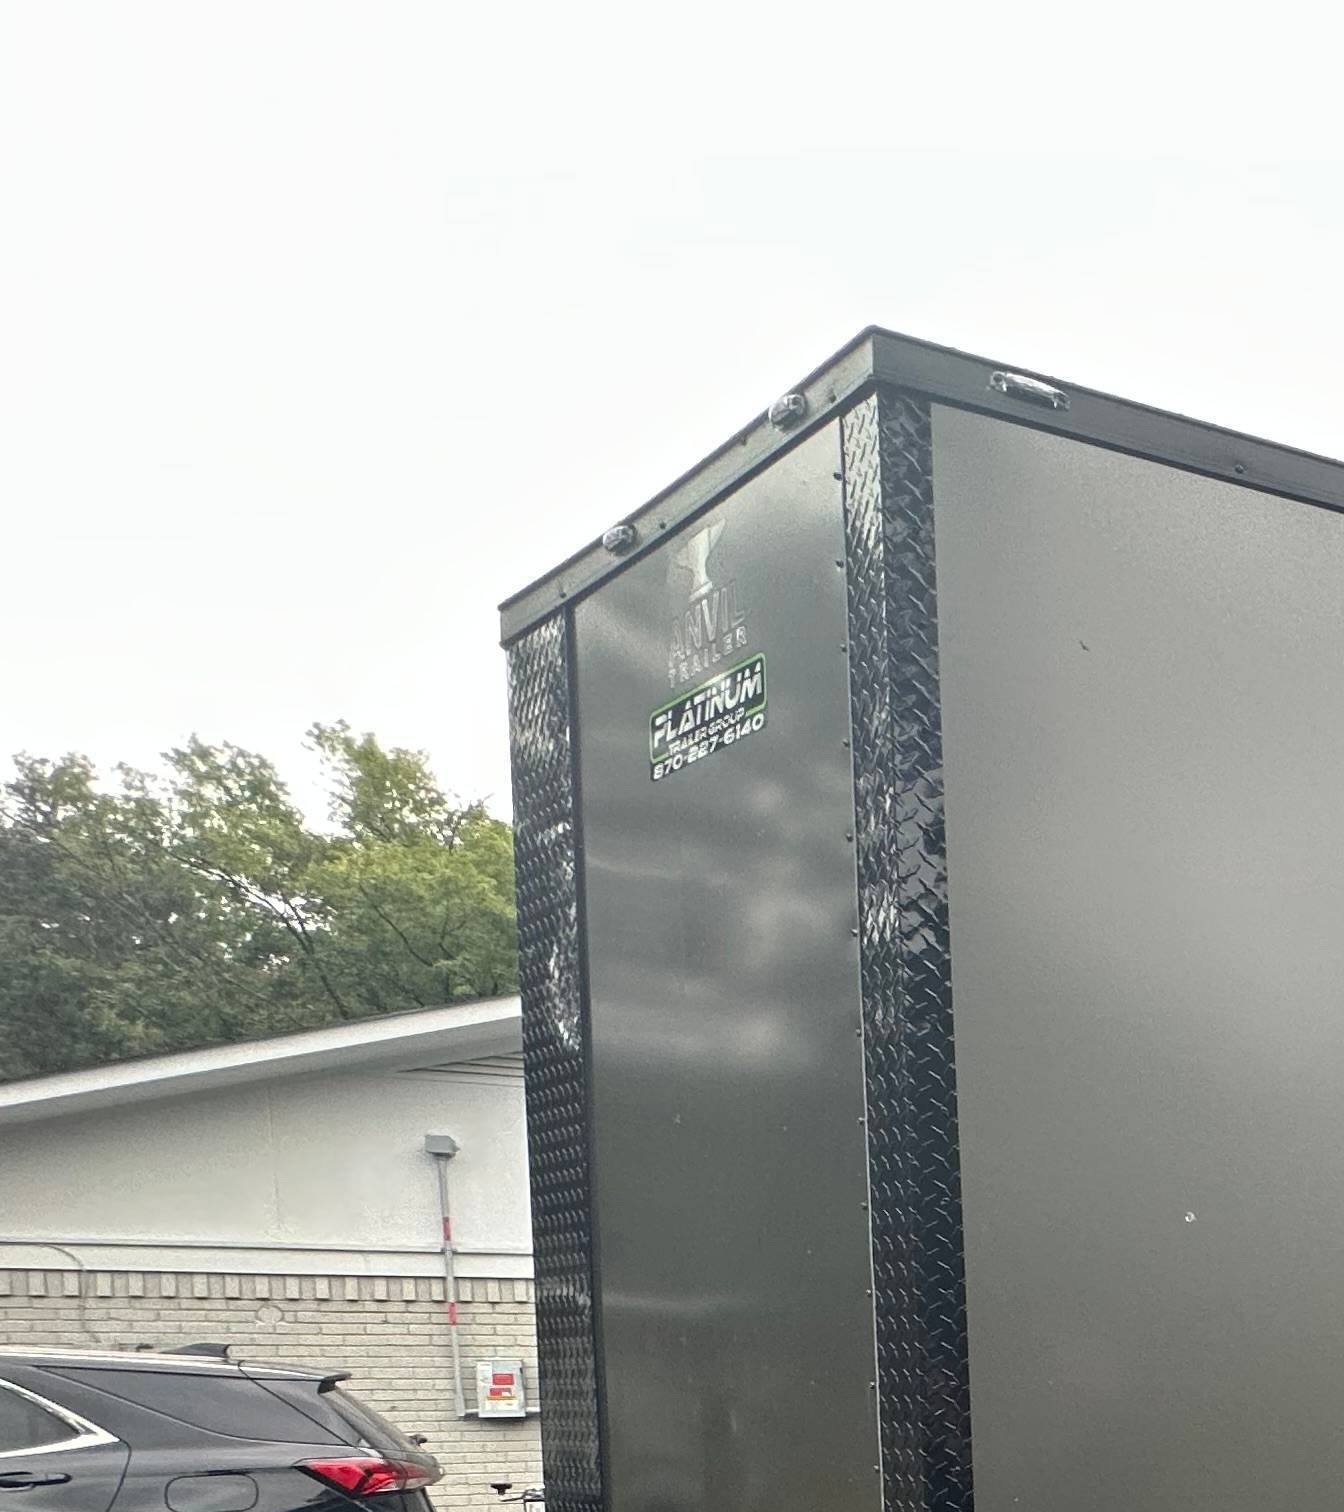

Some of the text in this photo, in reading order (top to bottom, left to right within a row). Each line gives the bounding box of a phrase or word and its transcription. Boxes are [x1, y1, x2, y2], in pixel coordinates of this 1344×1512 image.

[668, 626, 747, 688] TRAILER
[669, 581, 745, 666] ANVIL
[654, 661, 762, 748] PLATINUM
